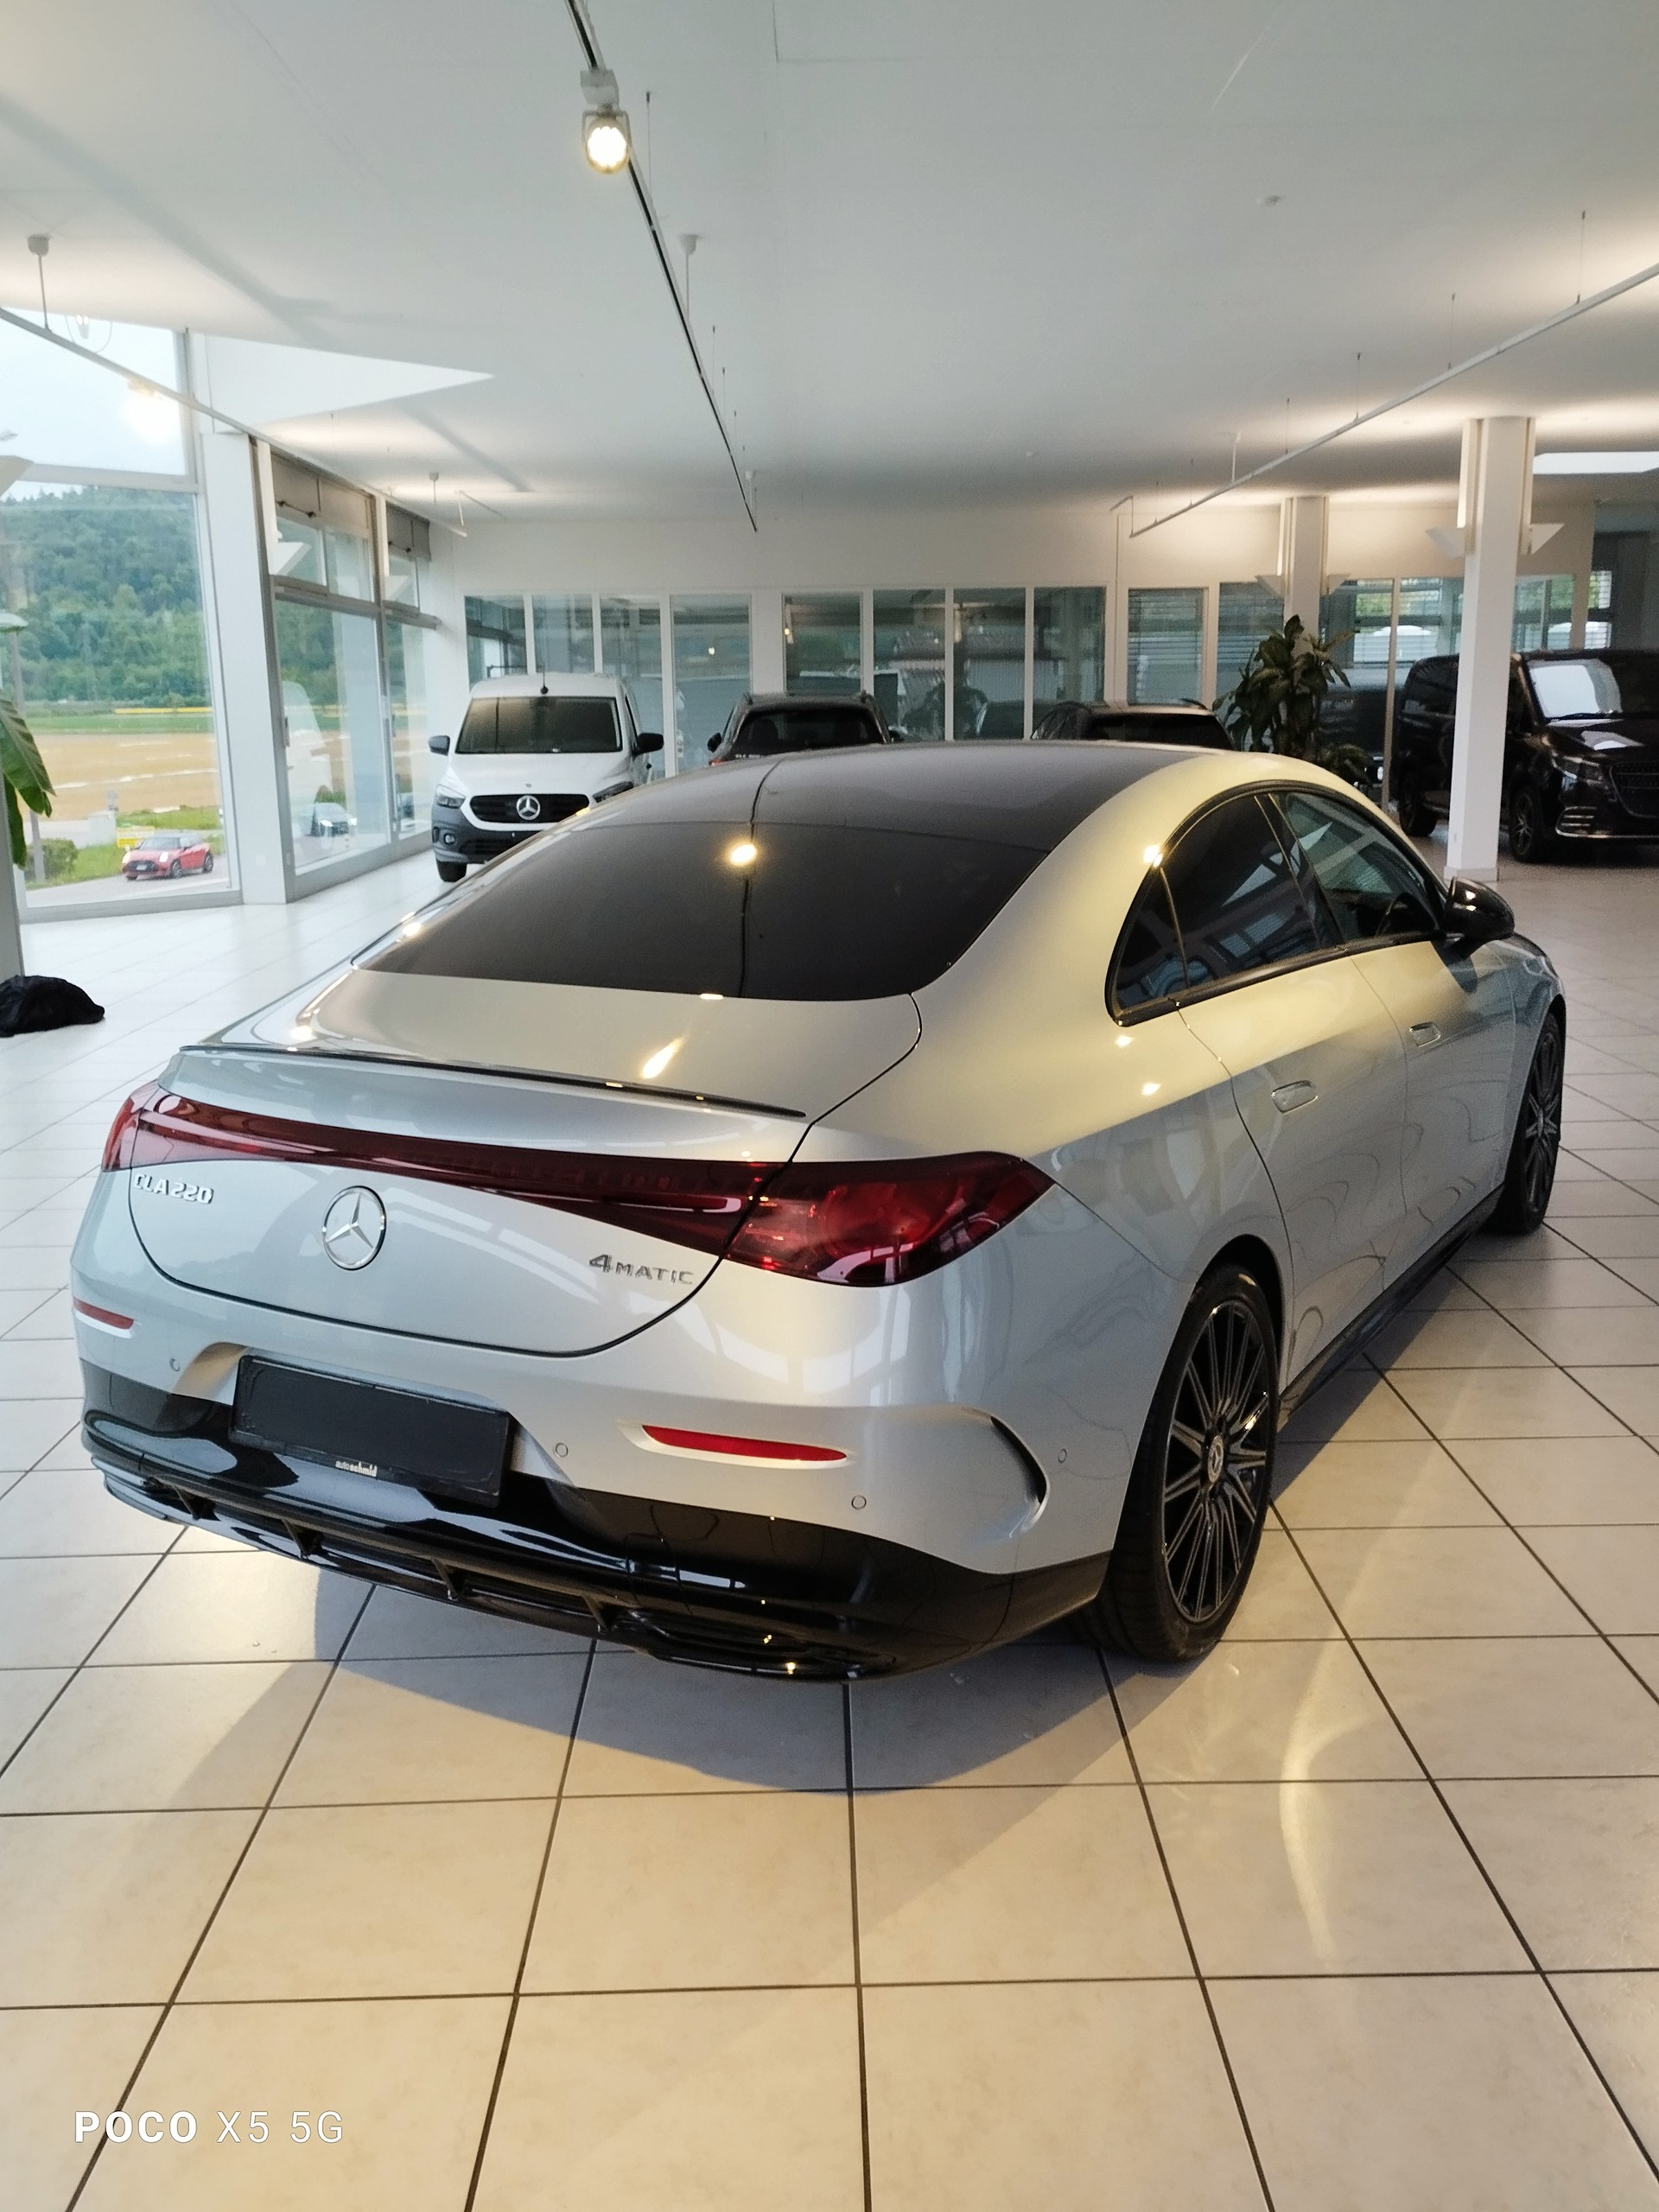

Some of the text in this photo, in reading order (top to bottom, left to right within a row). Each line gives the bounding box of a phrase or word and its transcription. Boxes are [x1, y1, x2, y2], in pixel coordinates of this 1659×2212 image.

[133, 1173, 214, 1205] CLA 220
[588, 1254, 694, 1285] 4MATIC
